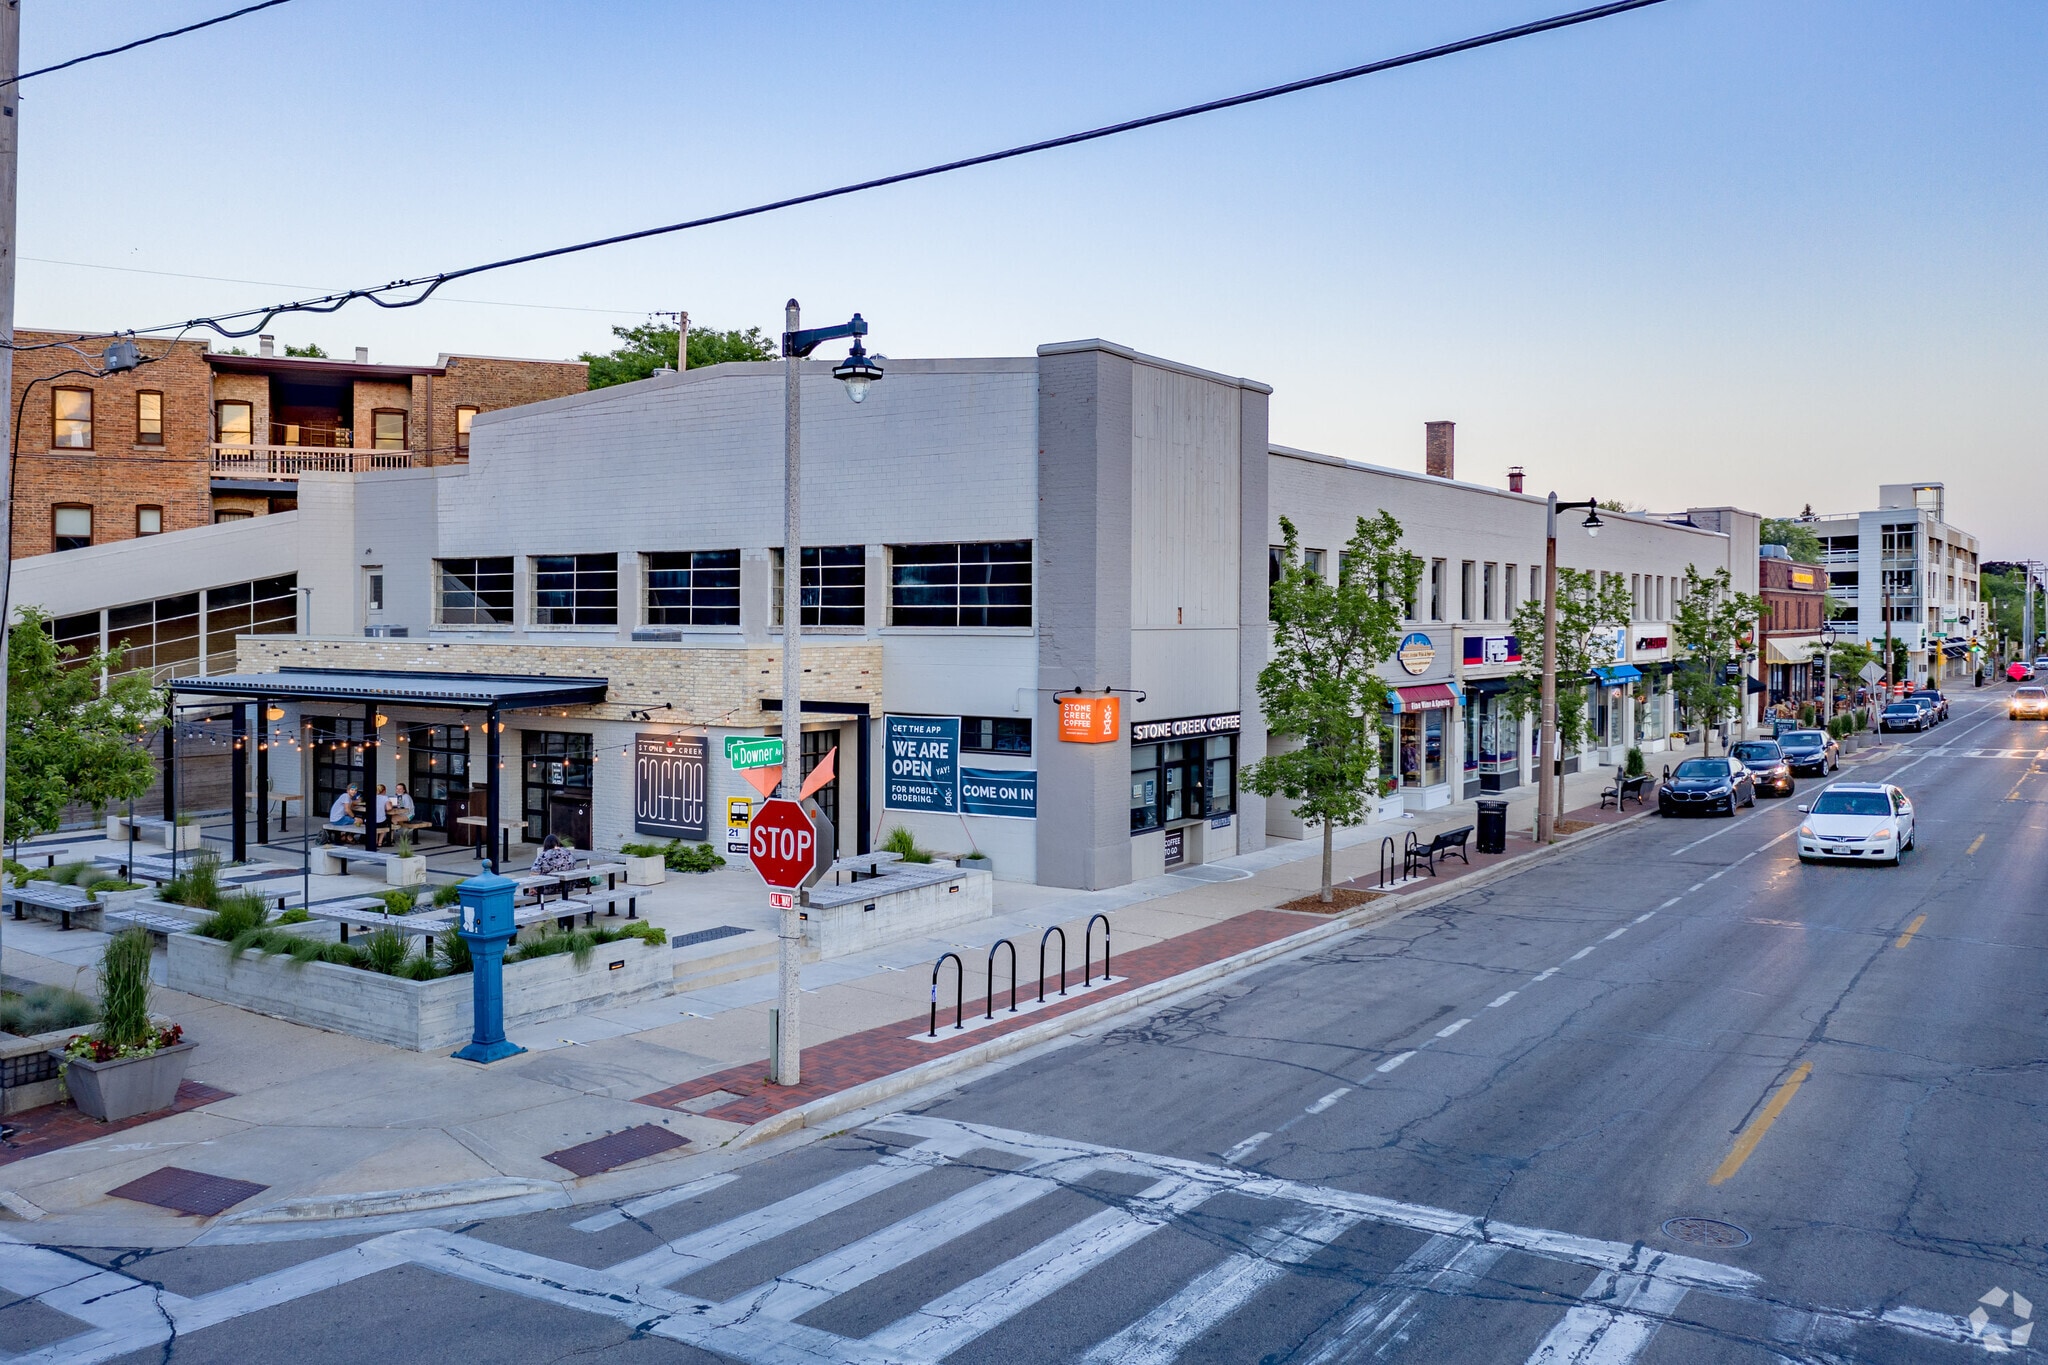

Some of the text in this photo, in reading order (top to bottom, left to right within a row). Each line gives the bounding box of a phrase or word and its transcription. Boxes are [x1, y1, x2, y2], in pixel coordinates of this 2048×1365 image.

[1064, 704, 1092, 712] STONE
[1064, 712, 1092, 720] CREEK
[892, 724, 908, 732] GET
[1064, 720, 1092, 728] COFFEE
[1133, 714, 1240, 740] STONE CREEK COFFEE
[892, 740, 949, 759] WE ARE
[734, 752, 739, 761] N
[740, 748, 773, 764] Downer
[892, 759, 950, 777] OPEN YAY!
[892, 784, 938, 795] FOR MOBILE
[963, 784, 1034, 800] COME ON IN
[892, 794, 934, 803] ORDERING.
[728, 828, 739, 836] 21
[752, 826, 812, 862] STOP
[1165, 837, 1180, 846] COFFEE
[771, 894, 791, 907] ALL WAY
